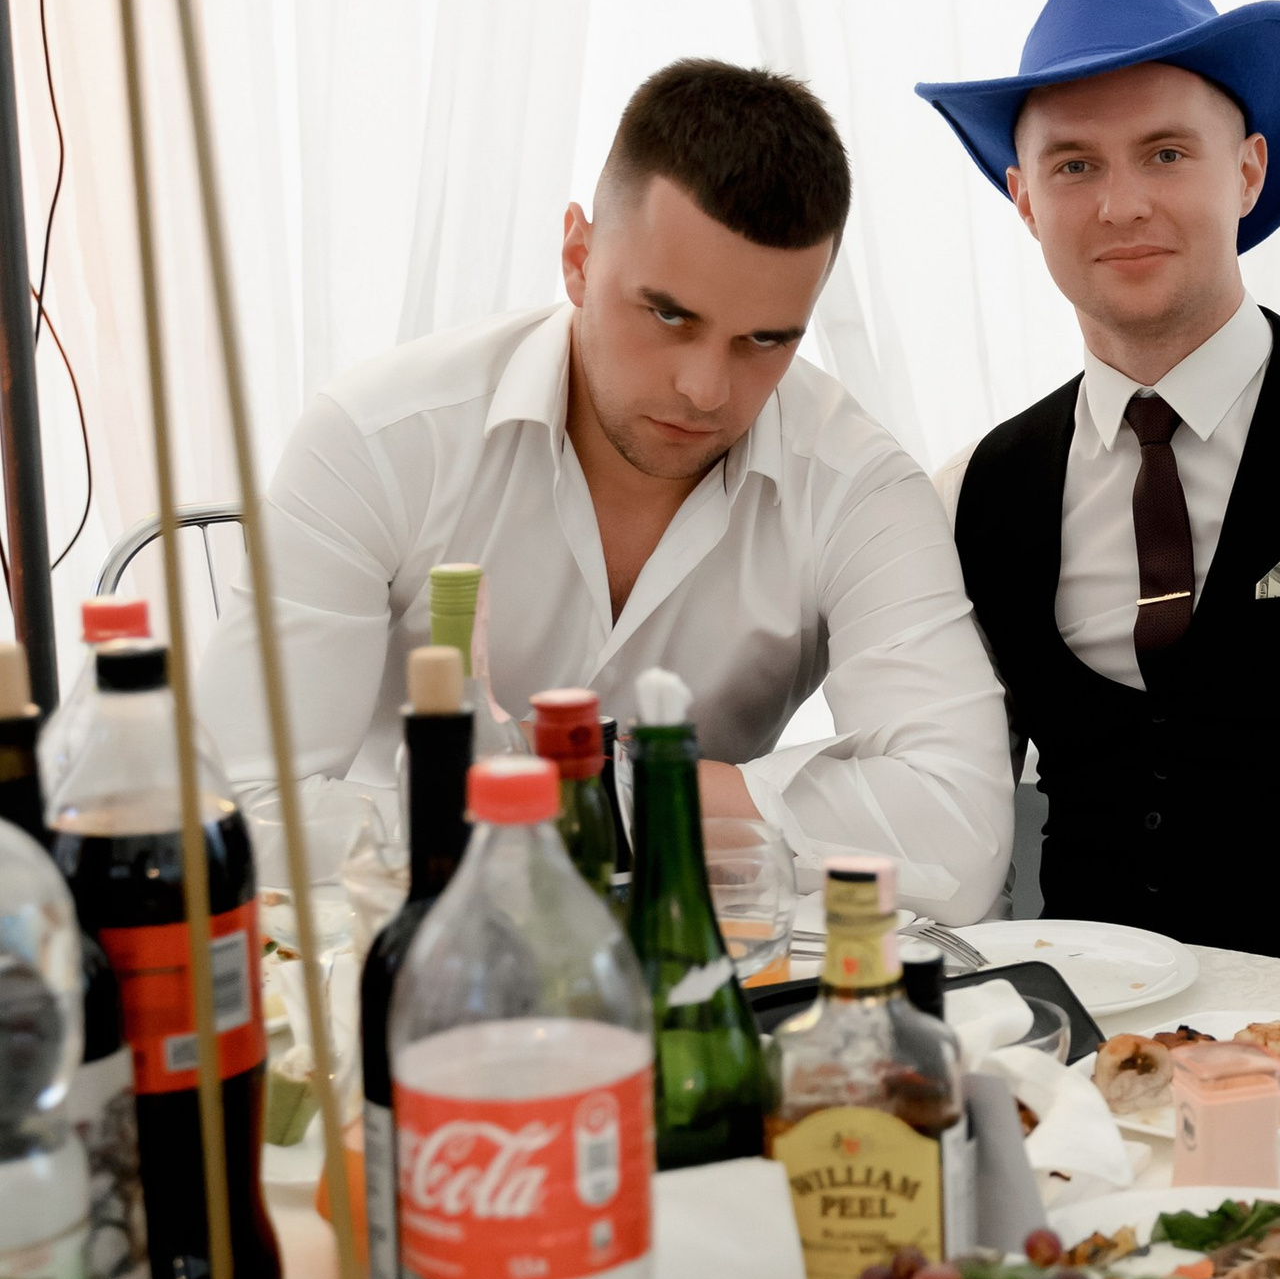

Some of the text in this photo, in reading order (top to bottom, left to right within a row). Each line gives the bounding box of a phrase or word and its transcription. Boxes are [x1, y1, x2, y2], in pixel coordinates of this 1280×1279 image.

[411, 1118, 564, 1220] Cola
[790, 1165, 921, 1204] WILLIAM
[820, 1195, 897, 1220] PEEL
